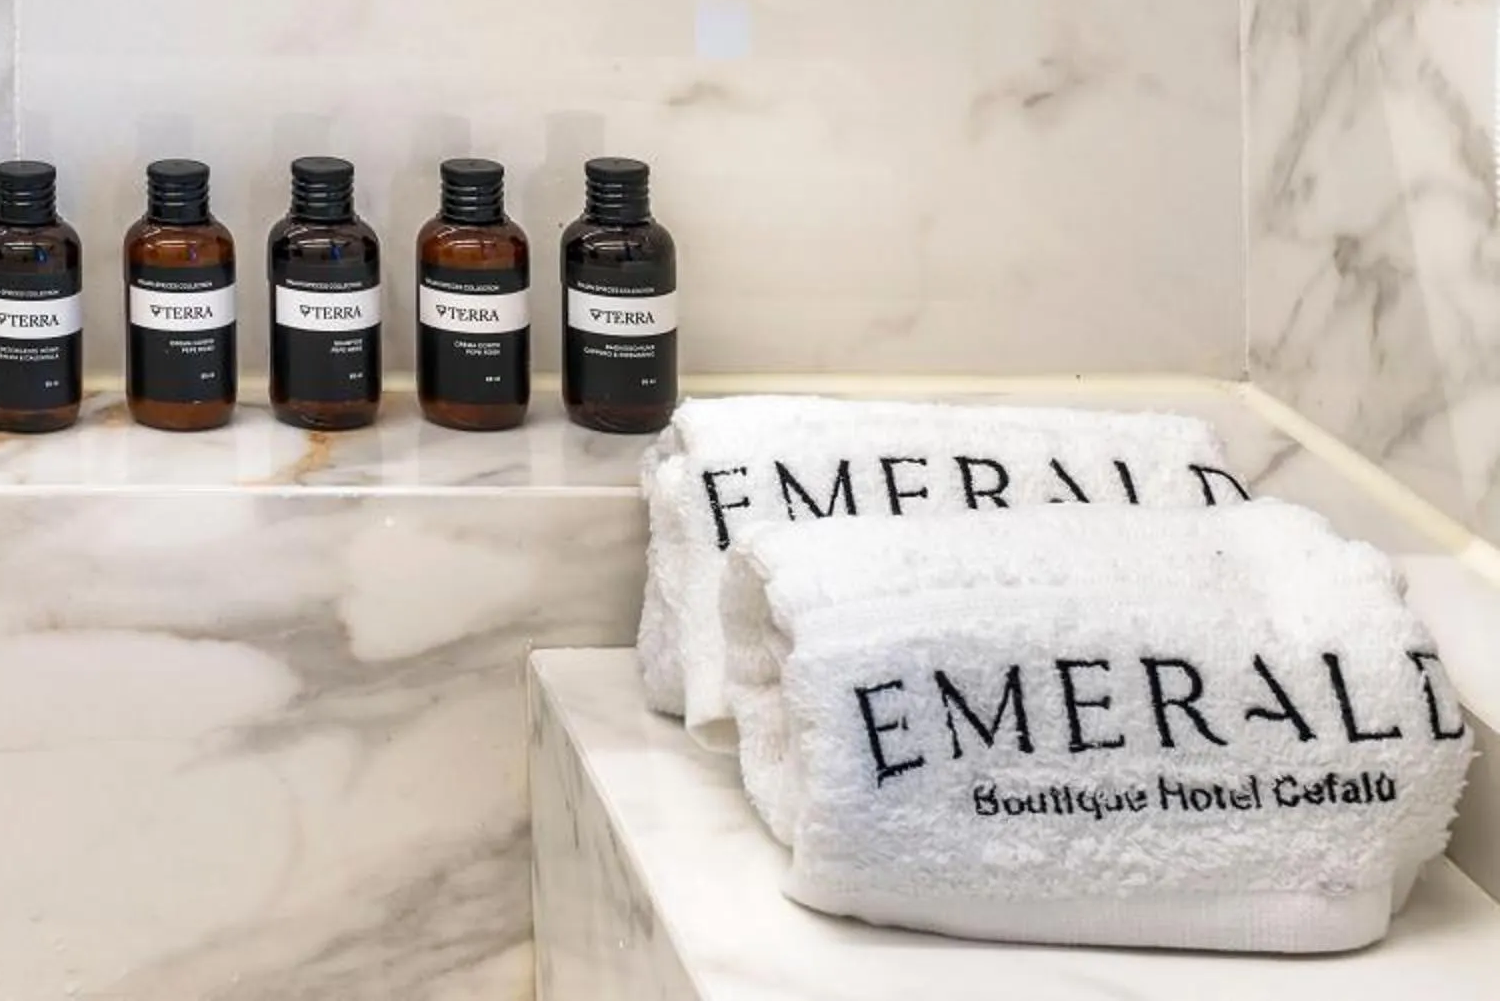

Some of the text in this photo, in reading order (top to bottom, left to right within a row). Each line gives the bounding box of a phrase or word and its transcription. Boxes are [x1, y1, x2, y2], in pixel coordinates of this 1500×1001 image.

[160, 306, 213, 320] TERRA
[311, 306, 363, 320] TERRA
[447, 306, 500, 322] TERRA
[602, 310, 656, 324] TERRA
[8, 314, 60, 327] TERRA
[972, 783, 1148, 820] Boutique
[1157, 774, 1263, 811] Hotel
